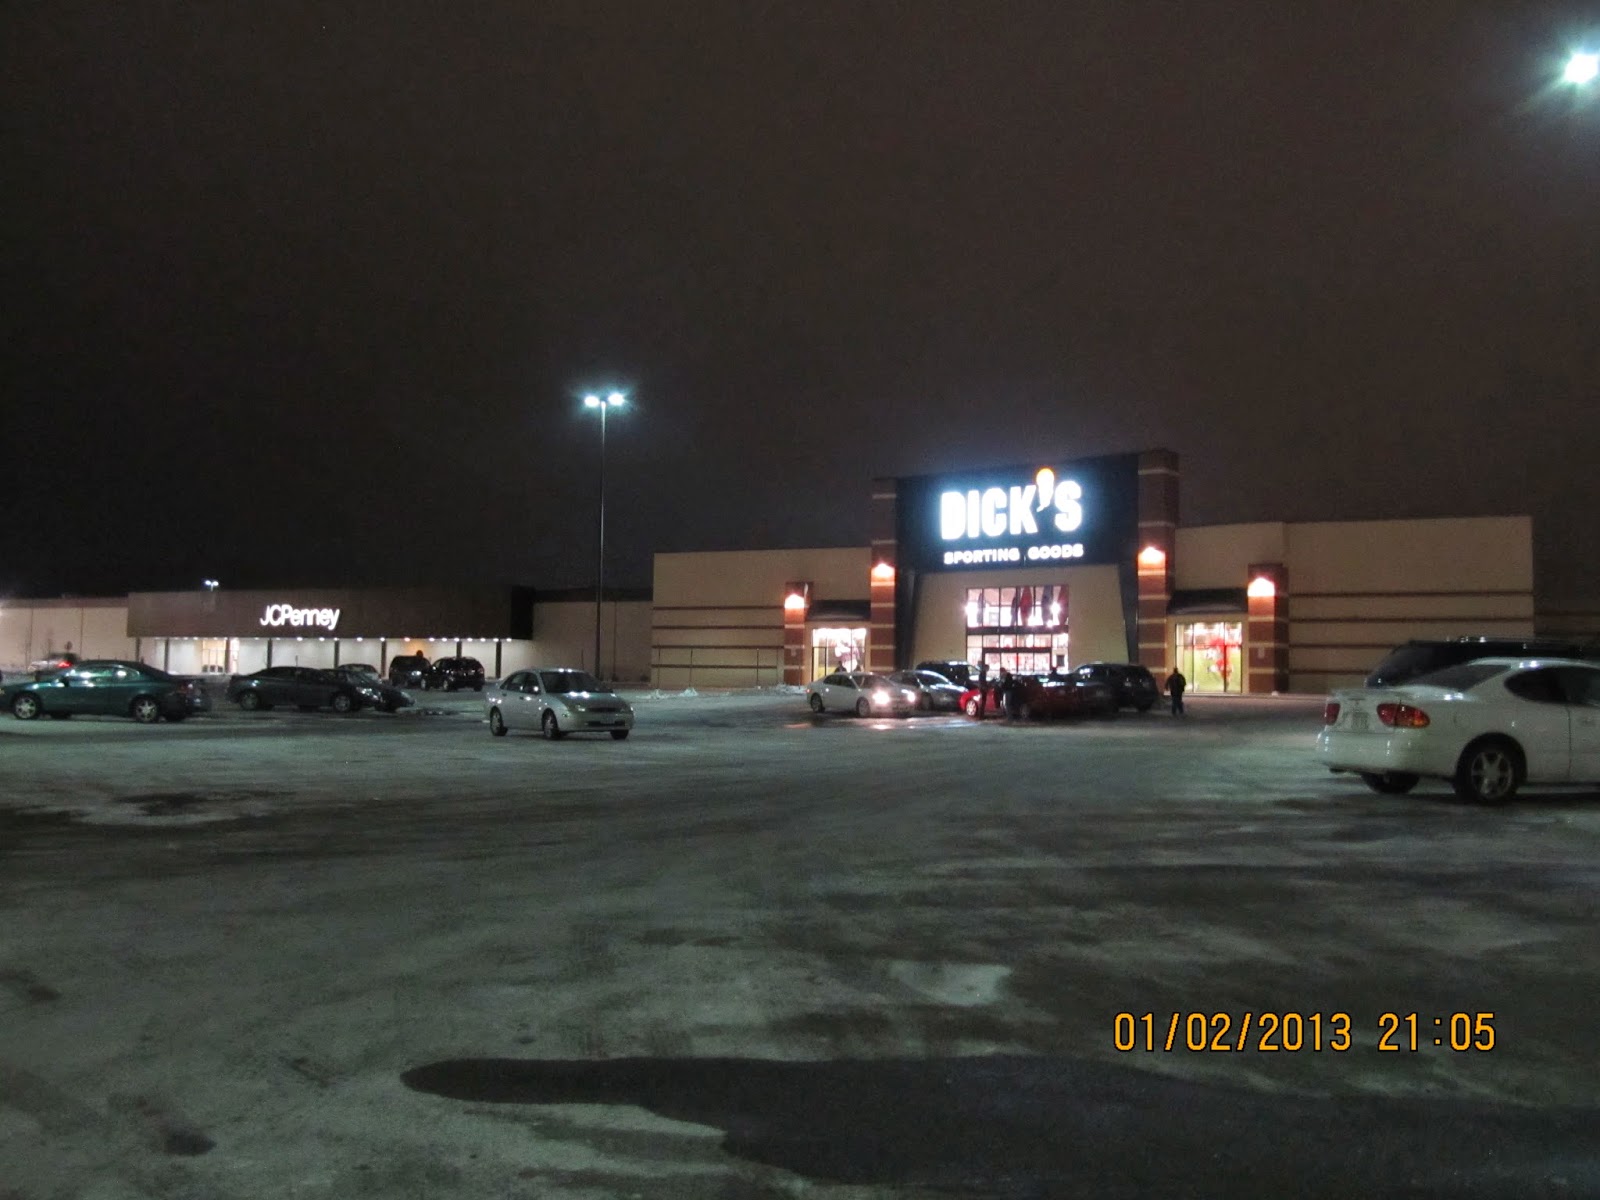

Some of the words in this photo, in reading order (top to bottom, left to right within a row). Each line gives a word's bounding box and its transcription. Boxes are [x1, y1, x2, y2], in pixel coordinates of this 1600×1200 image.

[940, 467, 1083, 540] DICK'S
[944, 547, 1020, 565] SPORTING
[1027, 543, 1084, 560] GOODS
[260, 604, 340, 630] JCPenney
